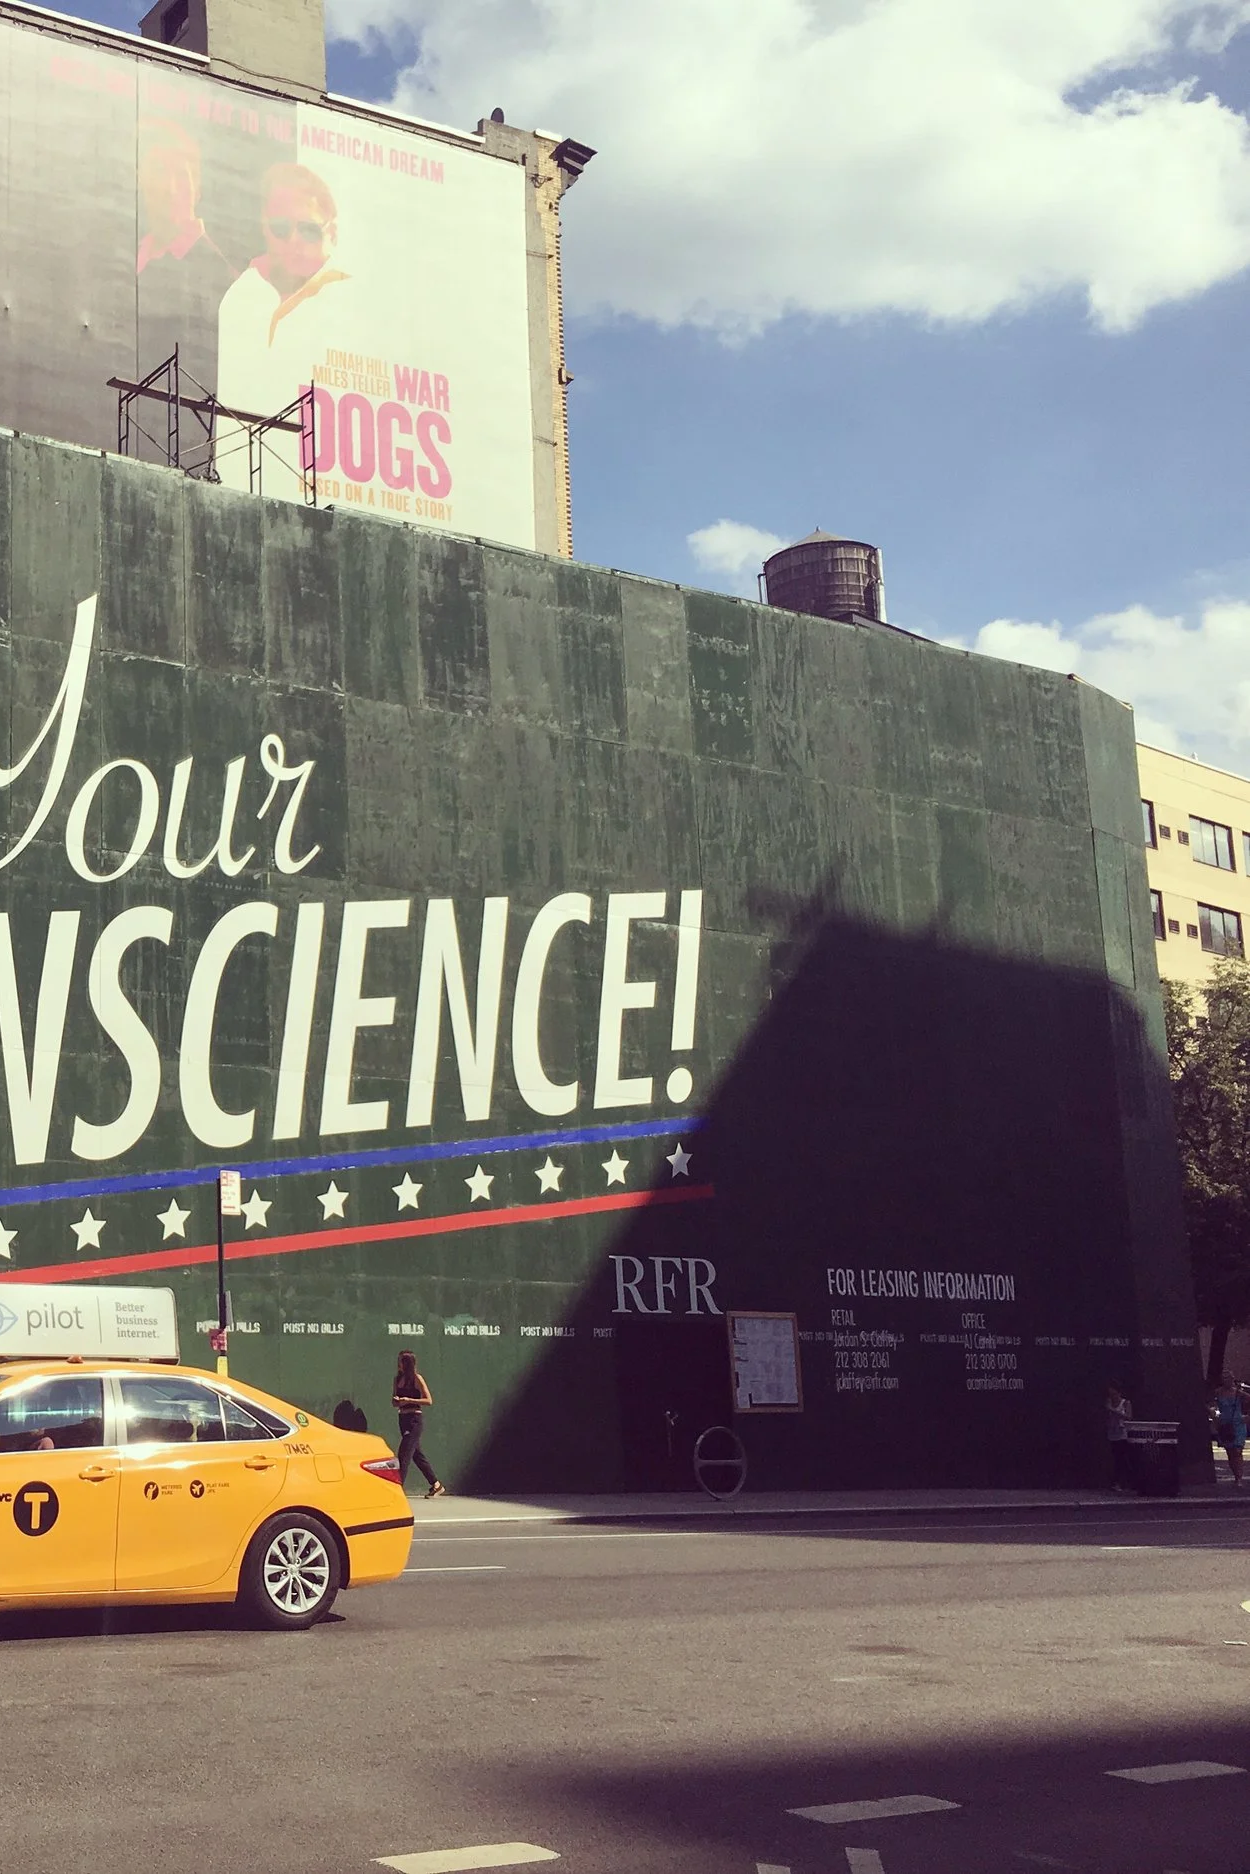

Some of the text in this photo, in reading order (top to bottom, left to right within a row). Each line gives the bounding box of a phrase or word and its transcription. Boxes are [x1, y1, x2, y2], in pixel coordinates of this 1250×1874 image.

[301, 124, 384, 168] AMERICAN
[389, 148, 444, 184] DREAM
[325, 348, 391, 379] JONAH HILL
[312, 364, 391, 399] MILES TELLER
[394, 363, 450, 413] WAR
[298, 384, 453, 500] DOGS
[345, 484, 363, 503] ON
[367, 488, 376, 507] A
[381, 490, 411, 514] TRUE
[415, 497, 454, 522] STORY
[608, 1254, 724, 1315] RFR
[827, 1268, 1015, 1301] FOR LEASING INFORMATION
[115, 1302, 145, 1313] Better
[27, 1302, 84, 1336] pilot
[116, 1314, 158, 1326] business
[831, 1309, 856, 1326] RETAIL
[961, 1312, 986, 1329] OFFICE
[117, 1327, 160, 1339] internet.
[283, 1322, 344, 1335] POST NO BILLS
[388, 1323, 400, 1335] NO
[444, 1325, 501, 1336] POST NO BILLS
[520, 1326, 540, 1337] POST
[541, 1326, 554, 1336] NO
[835, 1351, 890, 1368] 212 308 2061
[965, 1353, 1017, 1370] 212 308 0700
[23, 1492, 49, 1529] T
